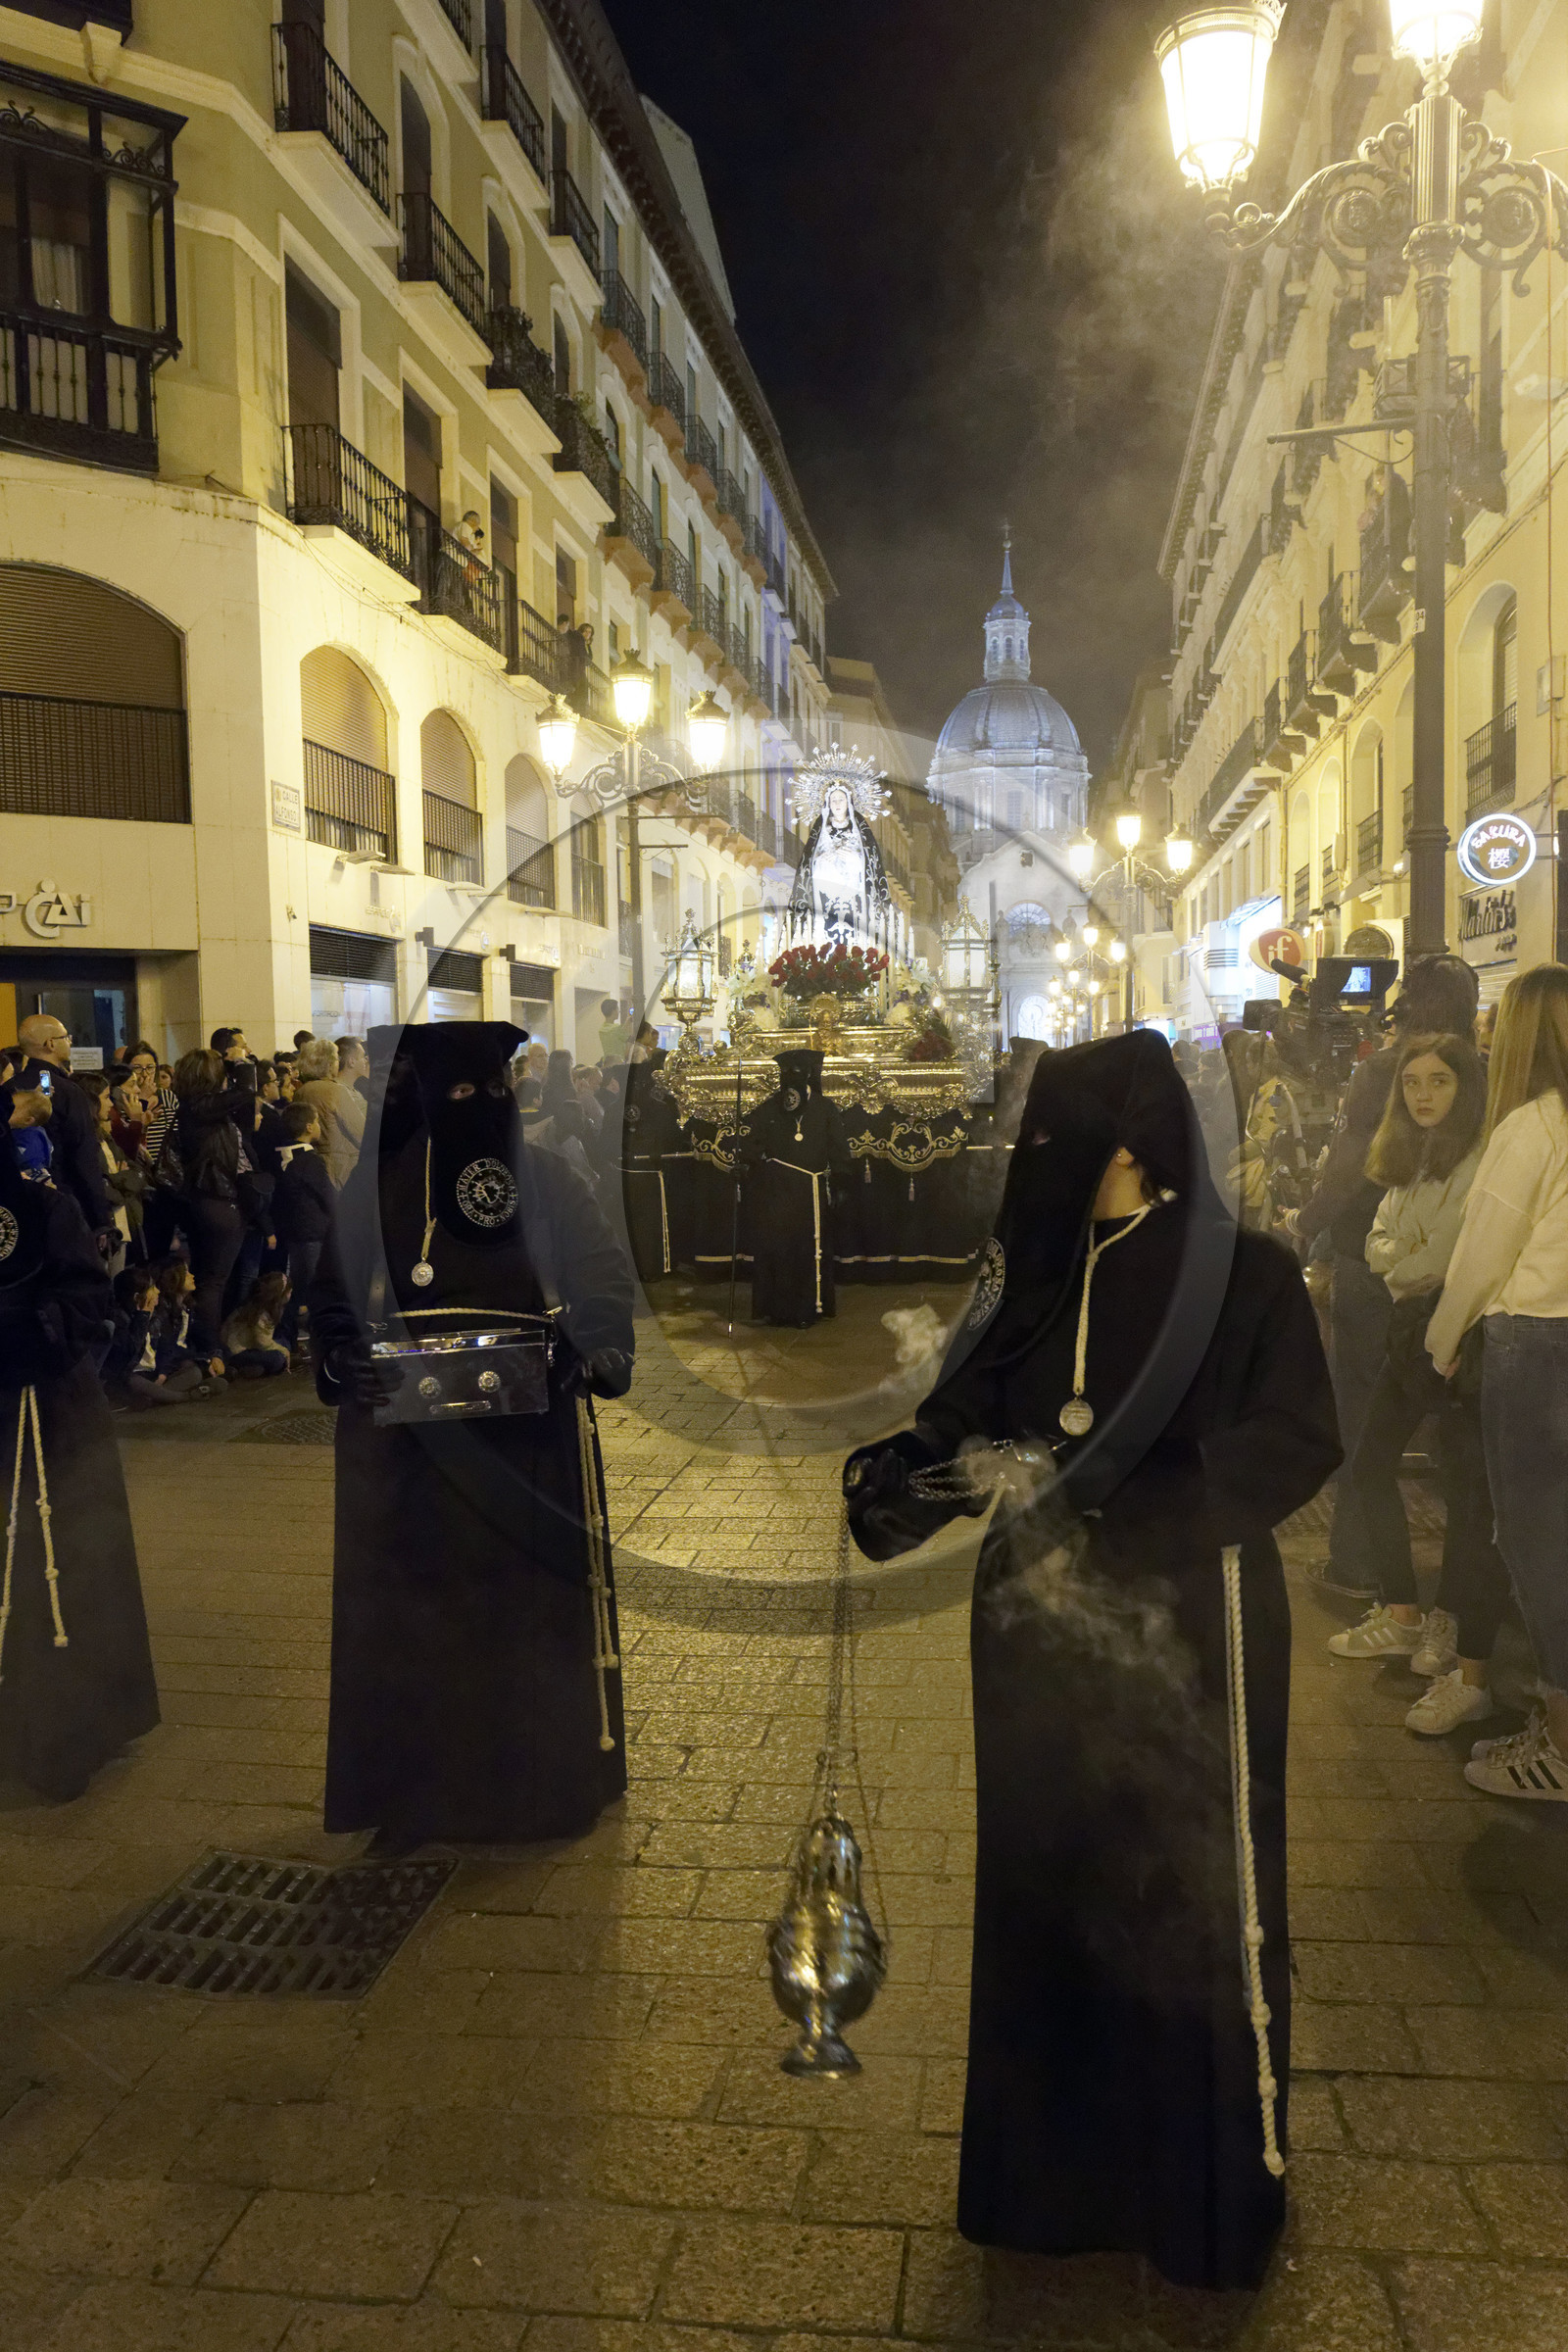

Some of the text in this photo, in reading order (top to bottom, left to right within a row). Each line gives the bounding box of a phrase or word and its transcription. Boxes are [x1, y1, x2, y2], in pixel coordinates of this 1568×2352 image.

[282, 790, 298, 805] CALLE
[275, 805, 297, 822] ALFONSO
[1471, 824, 1526, 849] SAKURA
[1268, 935, 1293, 966] if
[458, 1163, 480, 1193] MATER
[462, 1200, 516, 1225] ORA PRO NOBIS
